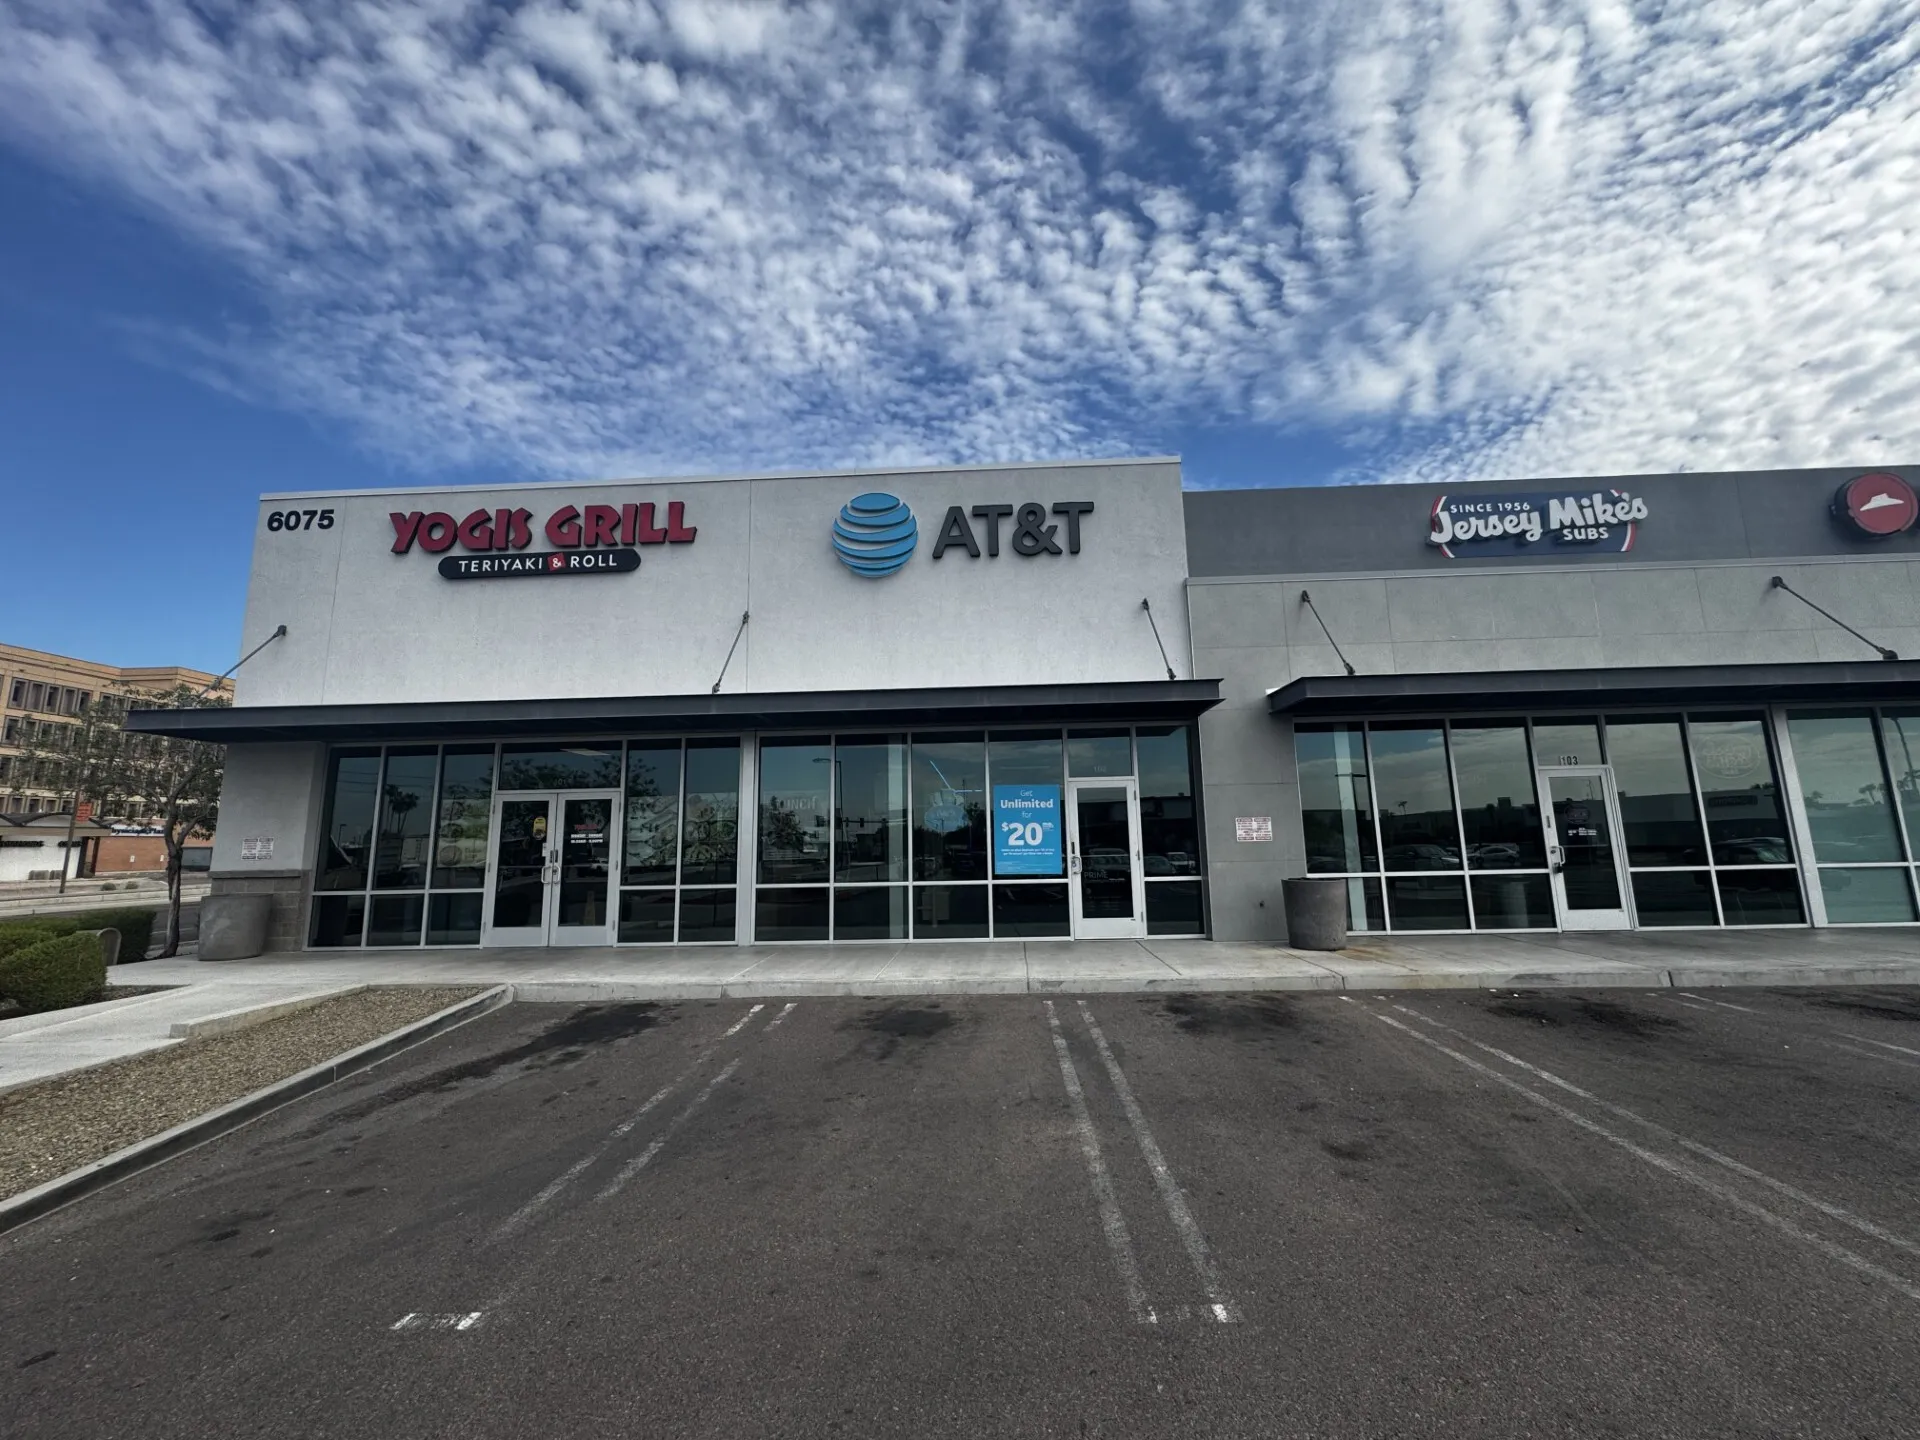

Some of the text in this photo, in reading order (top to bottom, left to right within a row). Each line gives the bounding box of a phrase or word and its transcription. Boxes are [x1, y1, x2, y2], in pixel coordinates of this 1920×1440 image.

[1430, 491, 1649, 544] Jersey Mike's
[1450, 502, 1531, 514] SINCE 1956
[267, 509, 335, 531] 6075
[389, 501, 697, 554] YOGIS GRILL
[932, 501, 1094, 560] AT&T
[1562, 527, 1609, 541] SUBS
[458, 554, 617, 573] TERIYAKI & ROLL
[1000, 798, 1054, 809] Unlimited
[1022, 811, 1032, 819] for
[1001, 821, 1043, 846] $20
[1083, 871, 1109, 880] PRIME
